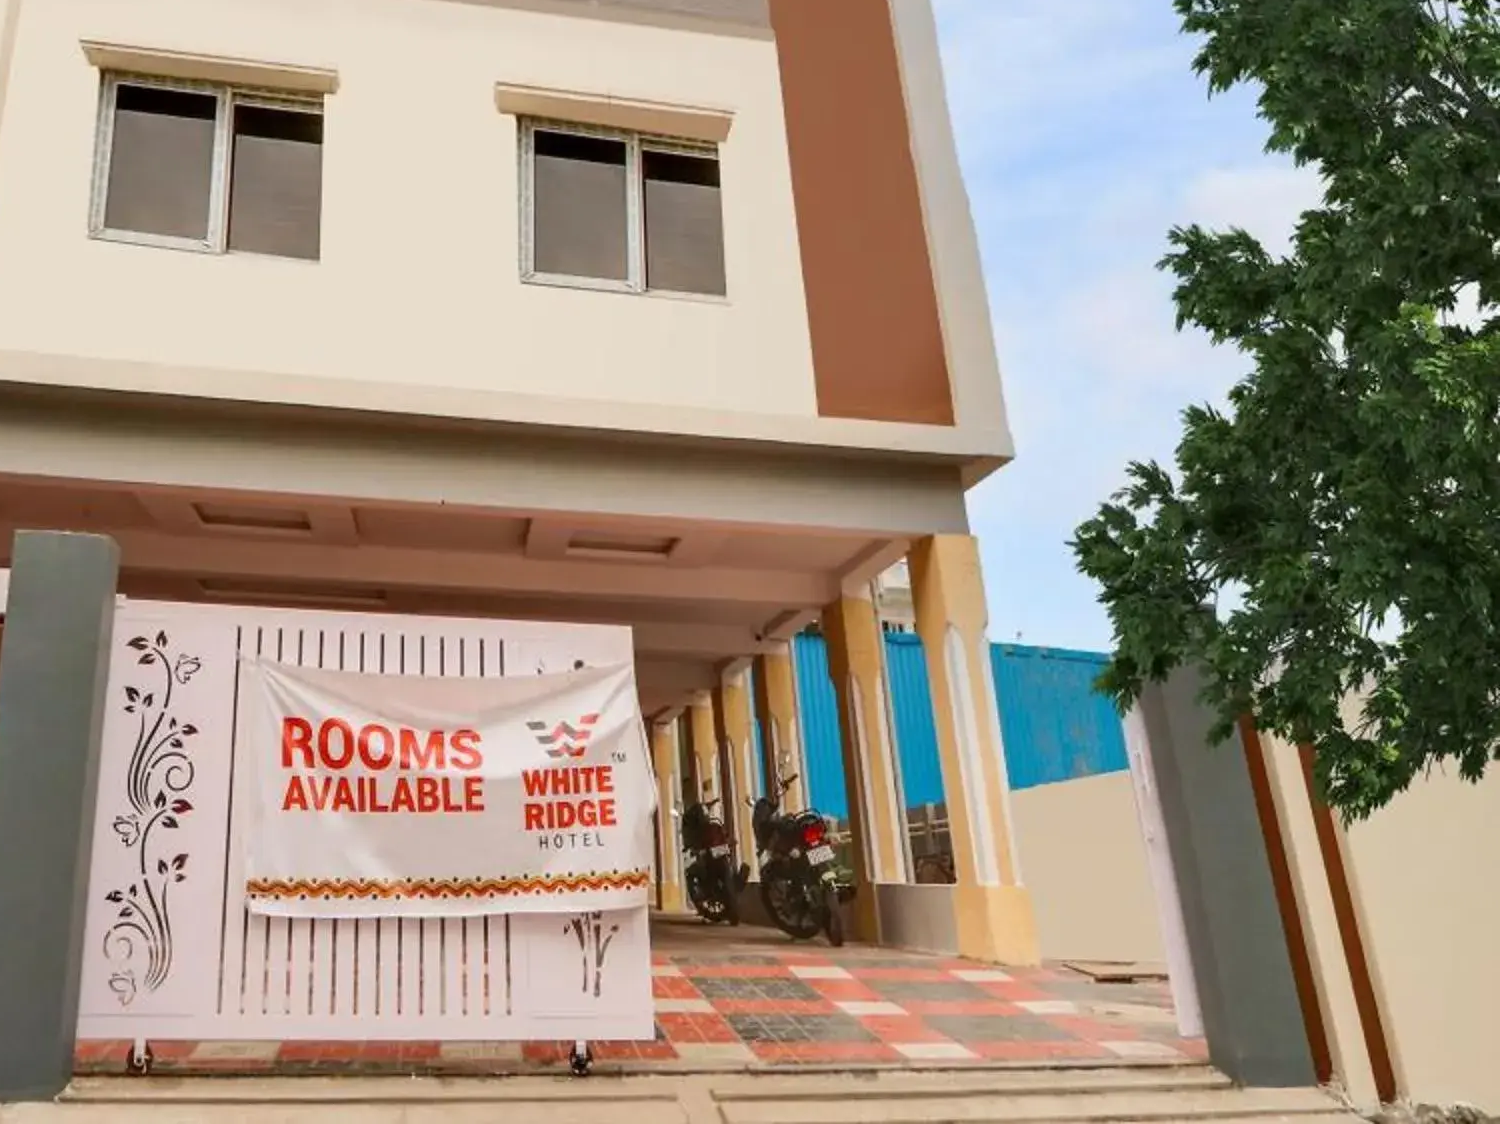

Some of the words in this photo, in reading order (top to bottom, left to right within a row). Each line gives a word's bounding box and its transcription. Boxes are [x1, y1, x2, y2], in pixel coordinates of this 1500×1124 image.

[281, 716, 484, 771] ROOMS
[281, 774, 485, 813] AVAILABLE
[521, 764, 615, 797] WHITE
[524, 798, 618, 832] RIDGE
[538, 832, 606, 850] HOTEL
